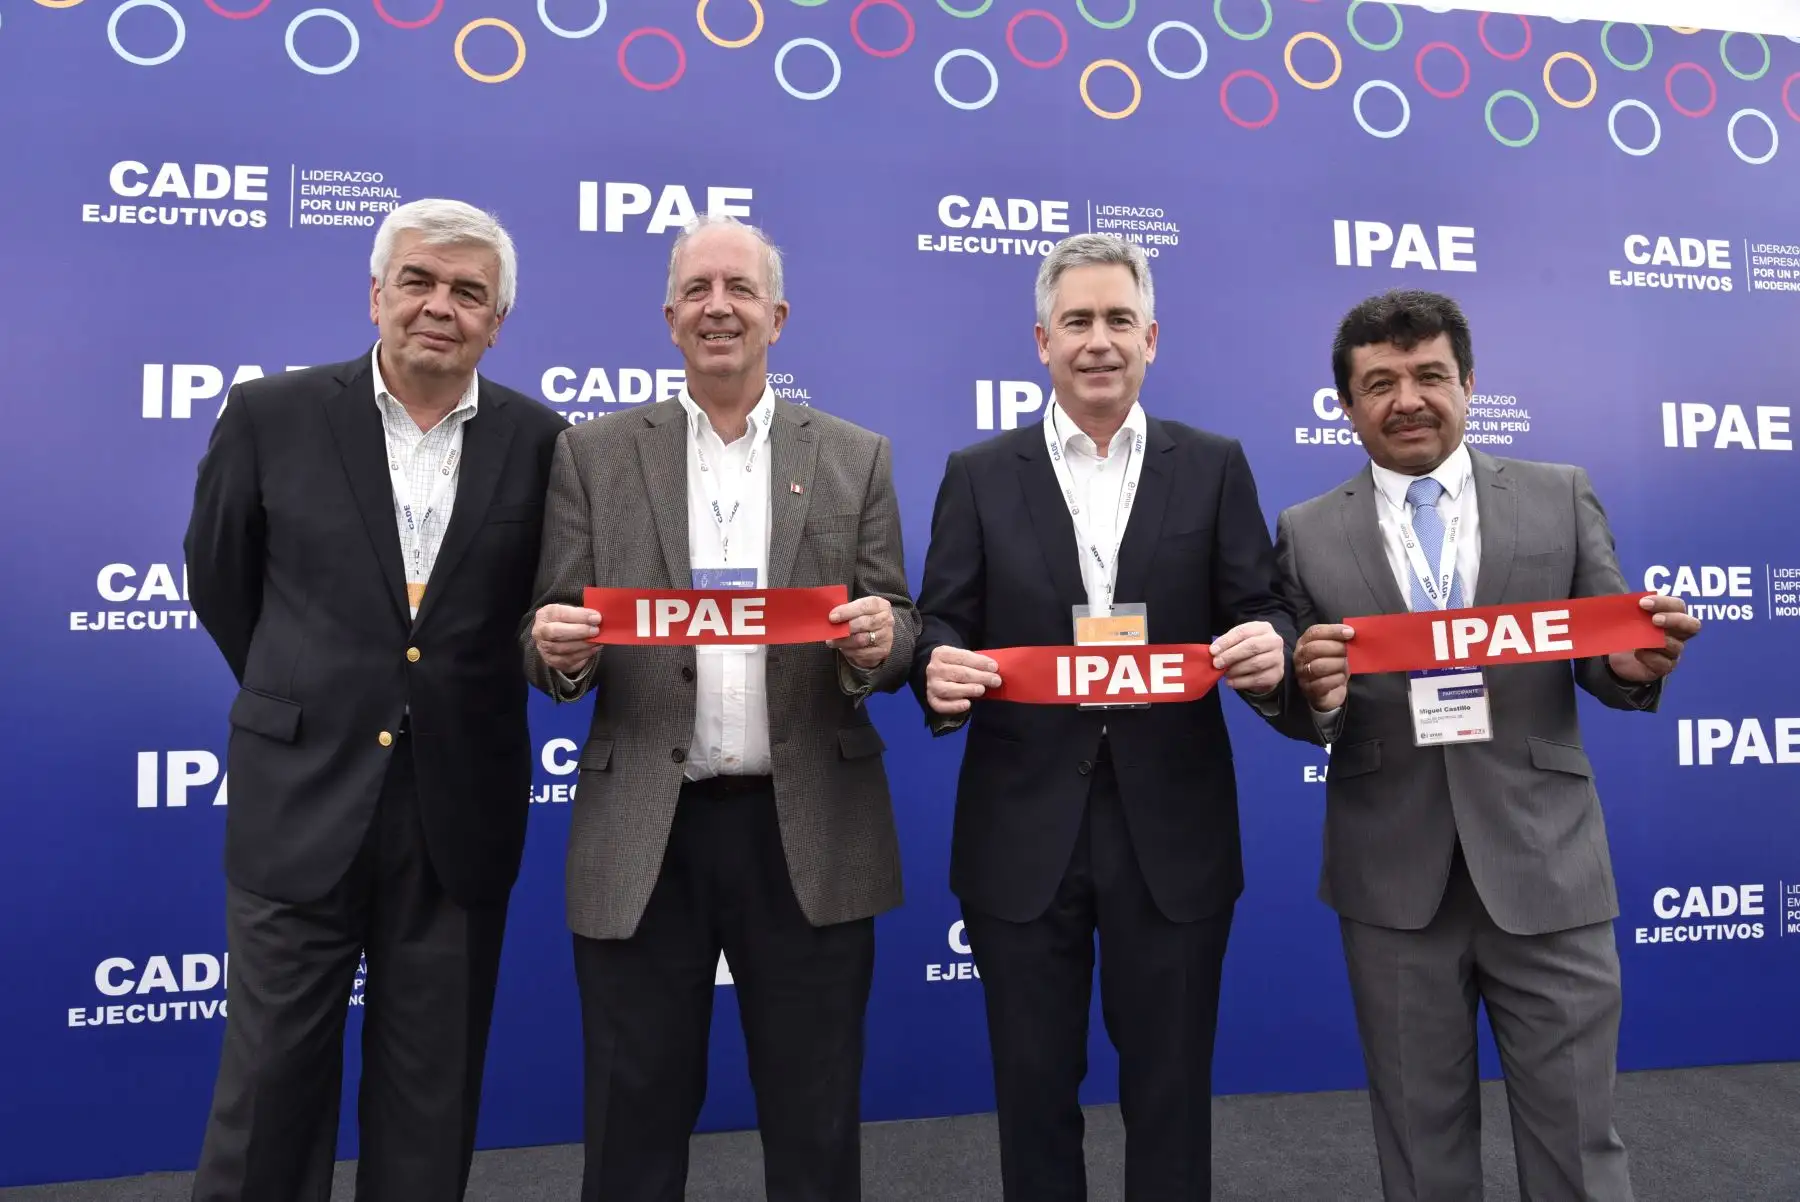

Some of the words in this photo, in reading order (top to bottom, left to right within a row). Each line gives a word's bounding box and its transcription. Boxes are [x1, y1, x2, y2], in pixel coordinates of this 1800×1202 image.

[109, 160, 268, 201] CADE
[301, 170, 384, 183] LIDERAZGO
[301, 184, 402, 199] EMPRESARIAL
[82, 204, 267, 228] EJECUTIVOS
[300, 199, 332, 211] POR
[335, 200, 356, 211] UN
[359, 200, 399, 213] PERÚ
[938, 194, 1070, 233] CADE
[1096, 204, 1164, 218] LIDERAZGO
[300, 213, 375, 227] MODERNO
[1096, 218, 1180, 232] EMPRESARIAL
[918, 234, 1063, 257] EJECUTIVO
[1146, 233, 1179, 246] PERÚ
[1333, 219, 1477, 273] IPAE
[1751, 243, 1800, 256] LIDERAZG
[1623, 234, 1732, 270] CADE
[1752, 255, 1800, 268] EMPRESA
[1609, 270, 1733, 292] EJECUTIVOS
[1753, 267, 1775, 278] POR
[1777, 269, 1791, 279] UN
[975, 379, 1043, 431] IP
[1482, 421, 1498, 431] UN
[1500, 420, 1531, 433] PERÚ
[1662, 401, 1793, 451] IPAE
[1050, 440, 1061, 462] CADE
[1134, 433, 1143, 455] CADE
[403, 504, 415, 531] CADE
[711, 499, 723, 524] CADE
[1422, 575, 1438, 600] CADE
[1643, 565, 1753, 597] CADE
[1775, 594, 1797, 604] POR
[69, 610, 198, 631] EJECUTI
[635, 597, 766, 638] IPAE
[1431, 609, 1573, 661] IPAE
[1056, 653, 1185, 697] IPAE
[1441, 688, 1480, 698] PARTICIPANTE
[1443, 704, 1472, 714] Castillo
[1677, 717, 1800, 766] IPAE
[1652, 884, 1765, 920] CADE
[1635, 922, 1765, 944] EJECUTIVOS
[94, 951, 229, 996] CAD
